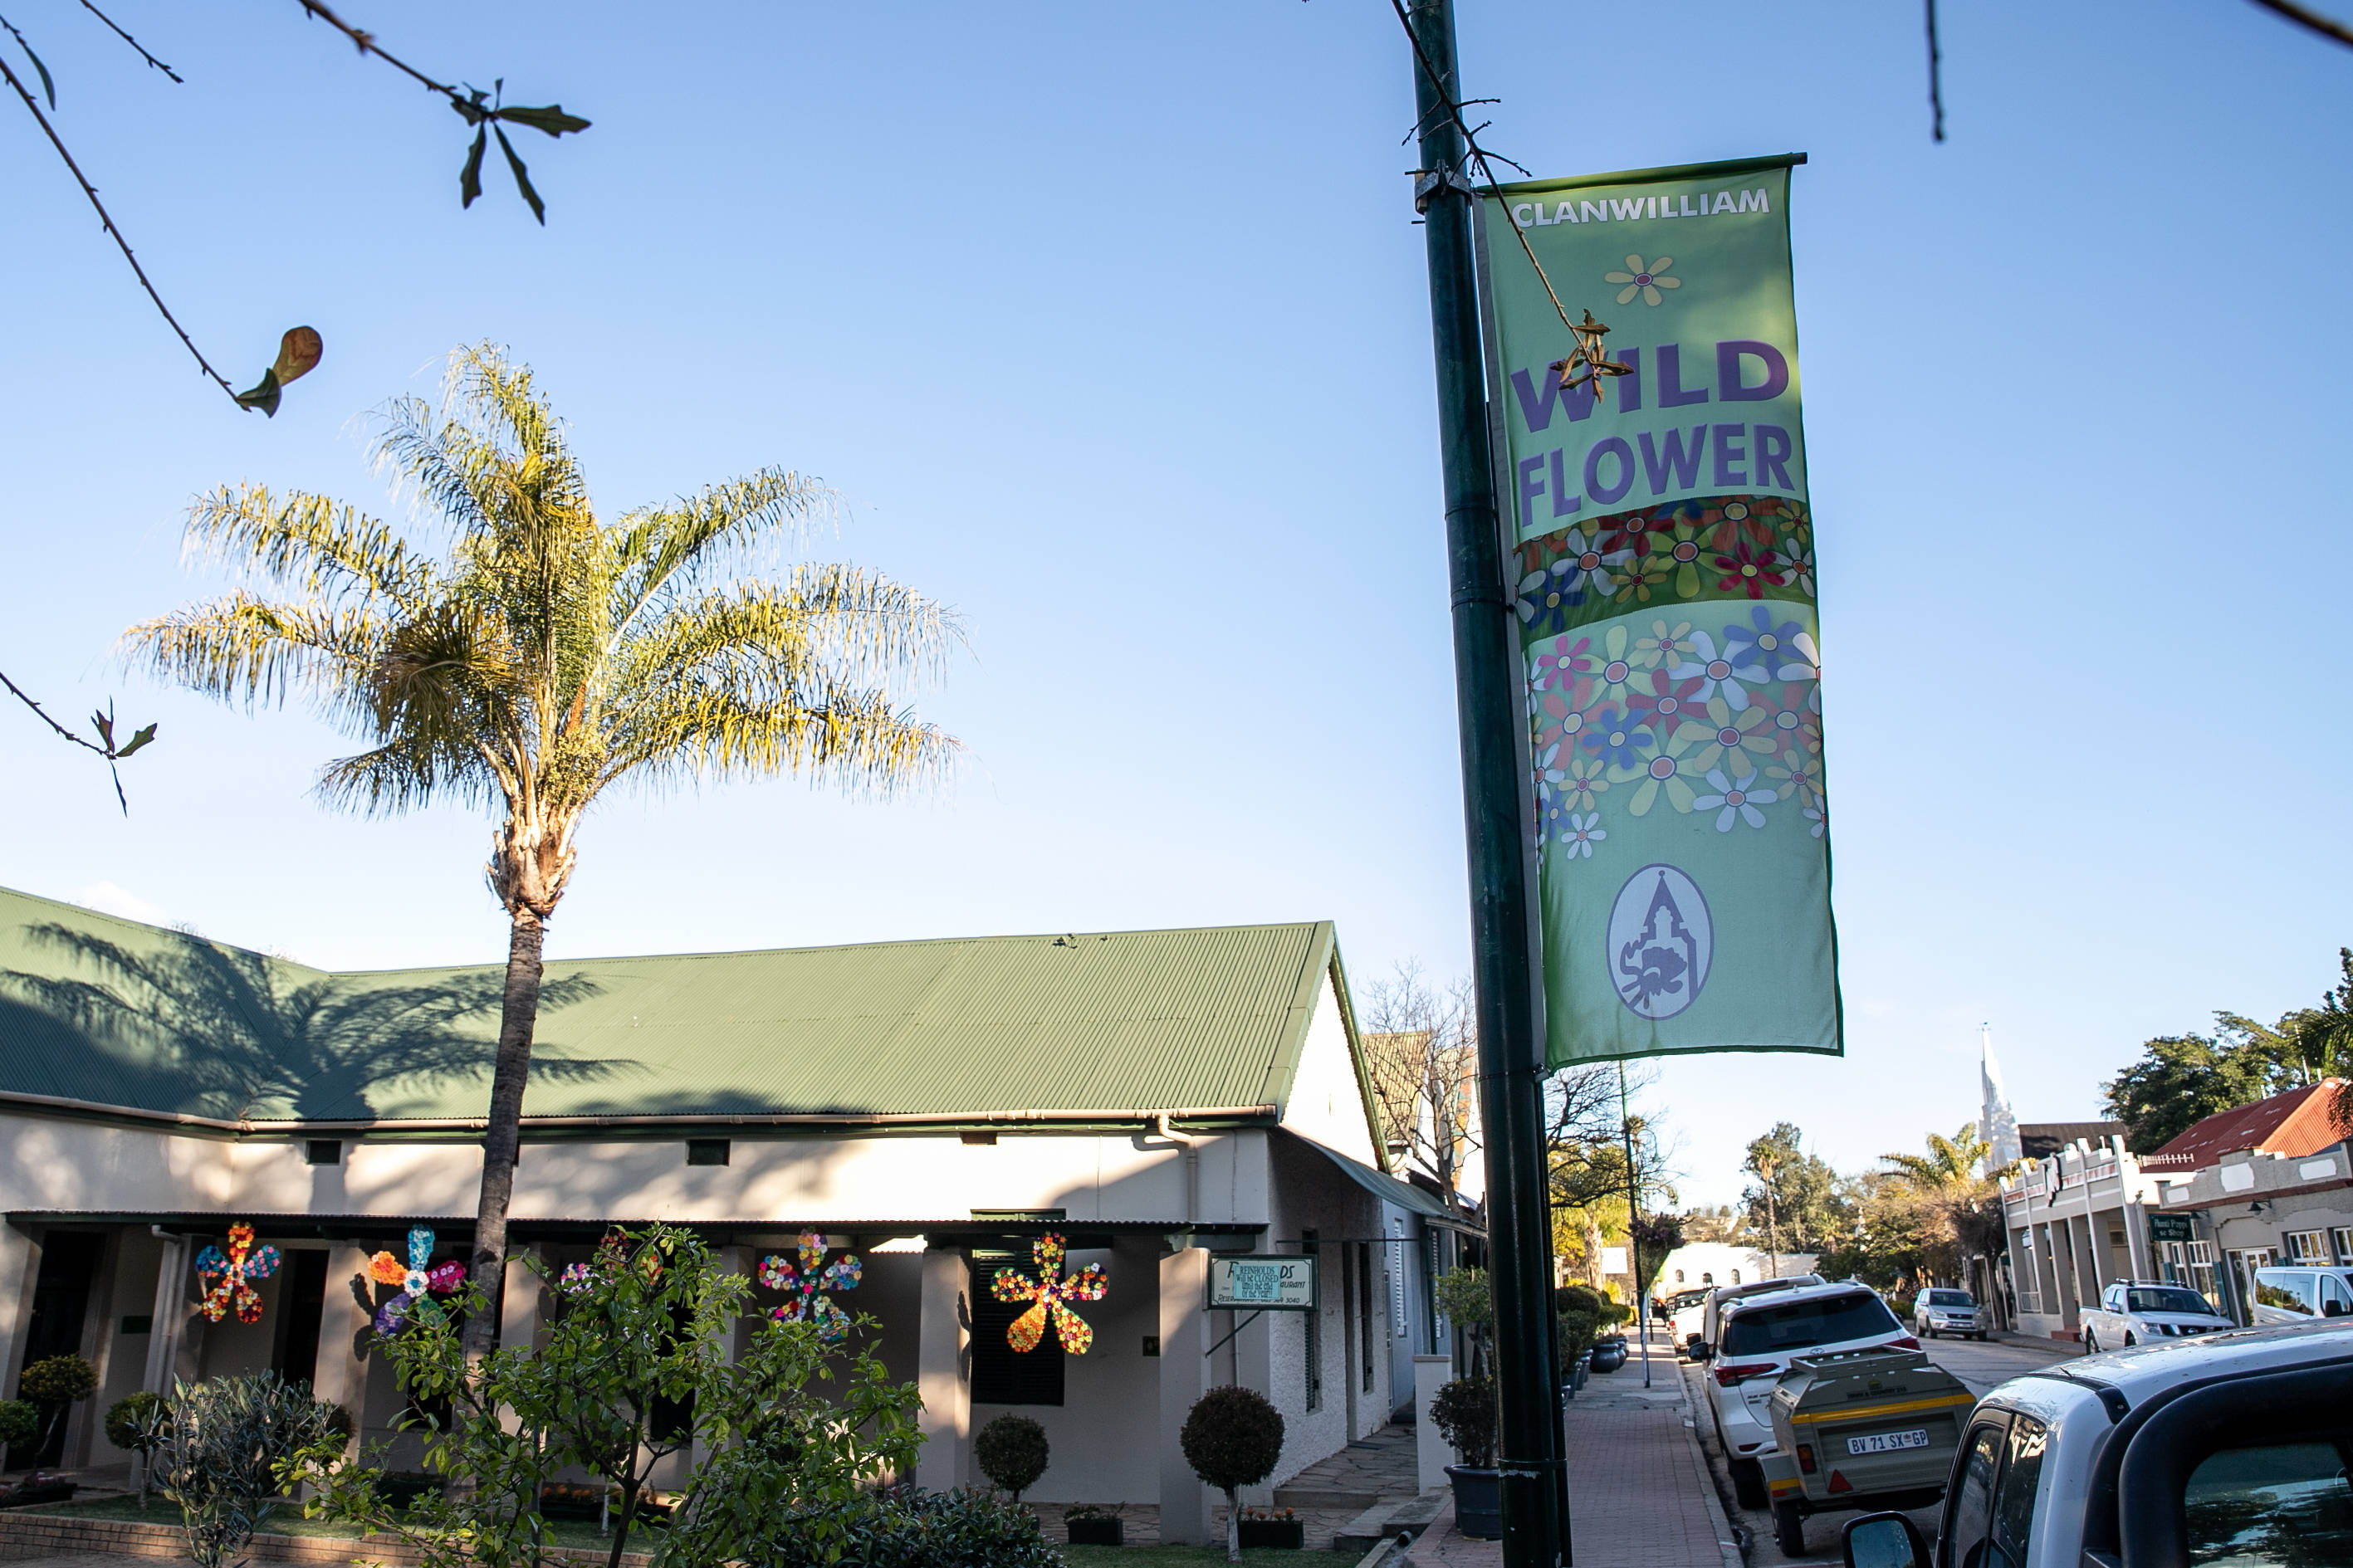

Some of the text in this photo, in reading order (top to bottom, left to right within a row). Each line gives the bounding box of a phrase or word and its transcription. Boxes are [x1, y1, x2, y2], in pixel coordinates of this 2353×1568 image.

[1511, 187, 1770, 228] CLANWILLIAM
[1509, 339, 1789, 433] WILD
[1518, 422, 1796, 527] FLOWER
[1240, 1266, 1275, 1276] REINHOLDS
[1254, 1274, 1279, 1282] CLOSED
[1852, 1431, 1926, 1452] BV 71 SX GP
